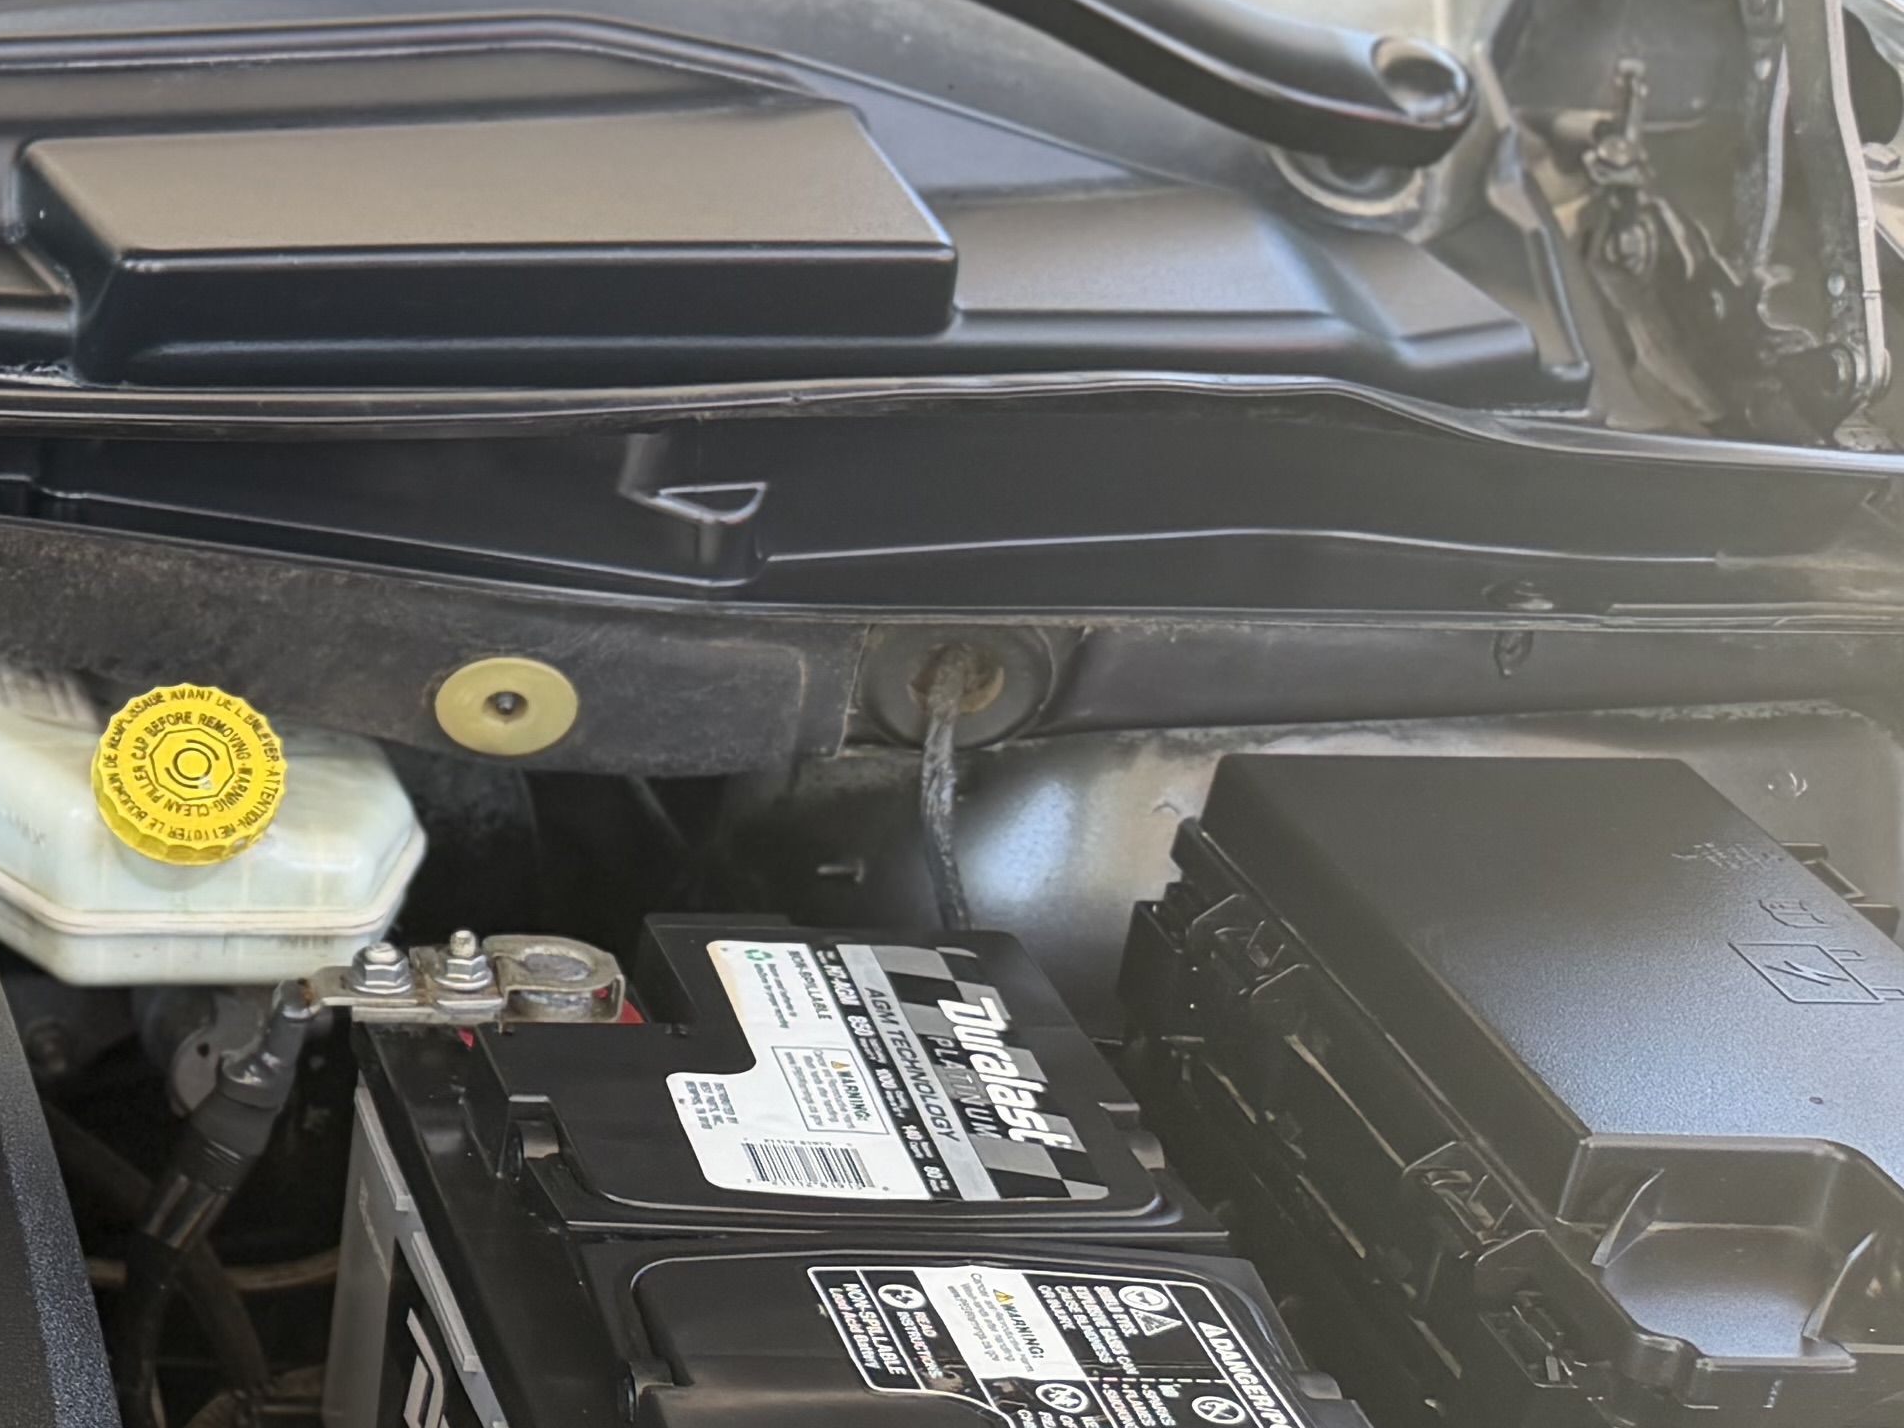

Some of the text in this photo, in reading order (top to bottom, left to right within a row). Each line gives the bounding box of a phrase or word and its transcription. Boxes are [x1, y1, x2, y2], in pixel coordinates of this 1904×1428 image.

[131, 736, 150, 761] CAP
[144, 711, 192, 737] BEFORE
[197, 713, 252, 761] REMOVING
[170, 689, 213, 702] AVANT
[216, 696, 231, 711] DE
[864, 986, 898, 1027] AGM
[886, 1029, 960, 1142] TECHNOLOGY
[926, 1034, 1003, 1139] PLATINUM
[937, 996, 1073, 1149] Duralast
[843, 1283, 907, 1376] NON-SPILLABLE
[1001, 1303, 1044, 1359] WARNING:
